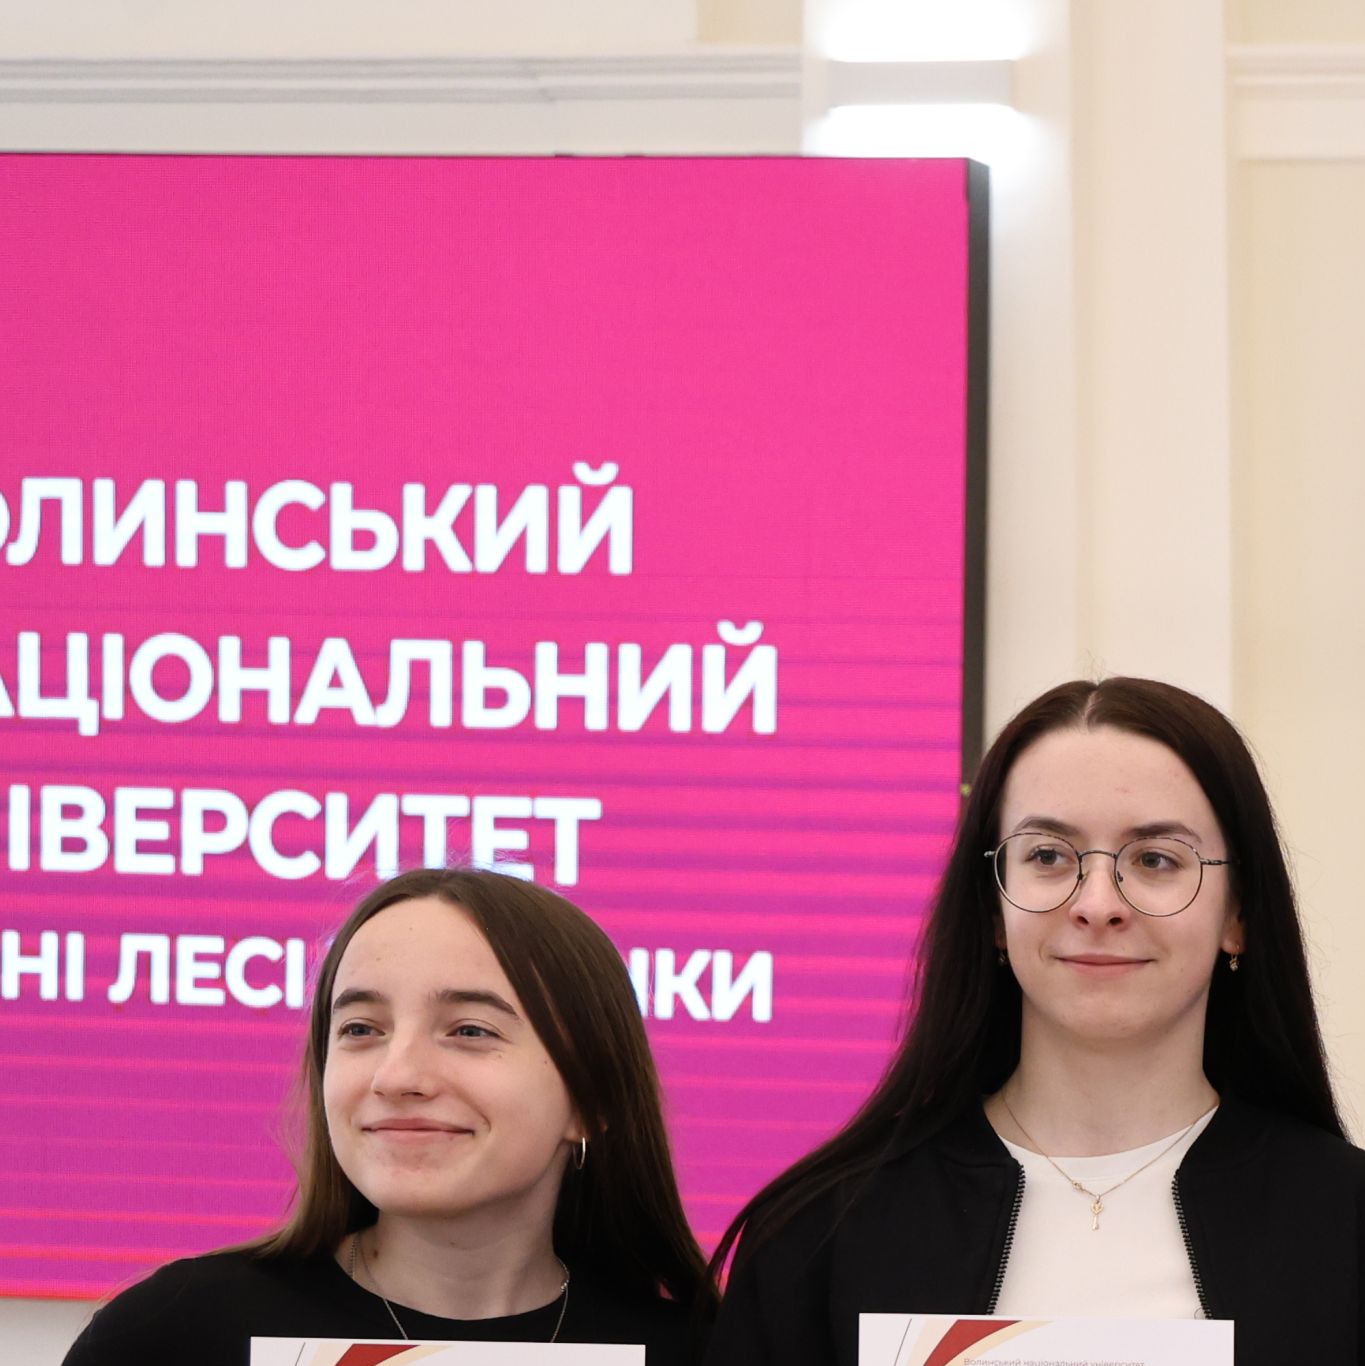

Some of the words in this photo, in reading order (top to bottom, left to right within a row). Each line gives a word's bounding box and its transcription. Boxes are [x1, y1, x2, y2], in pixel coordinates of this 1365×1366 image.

[0, 462, 633, 575] ЛИНСЬКИЙ
[0, 621, 778, 735] ЦІОНАЛЬНИЙ
[107, 932, 304, 1006] ЛЕСІ
